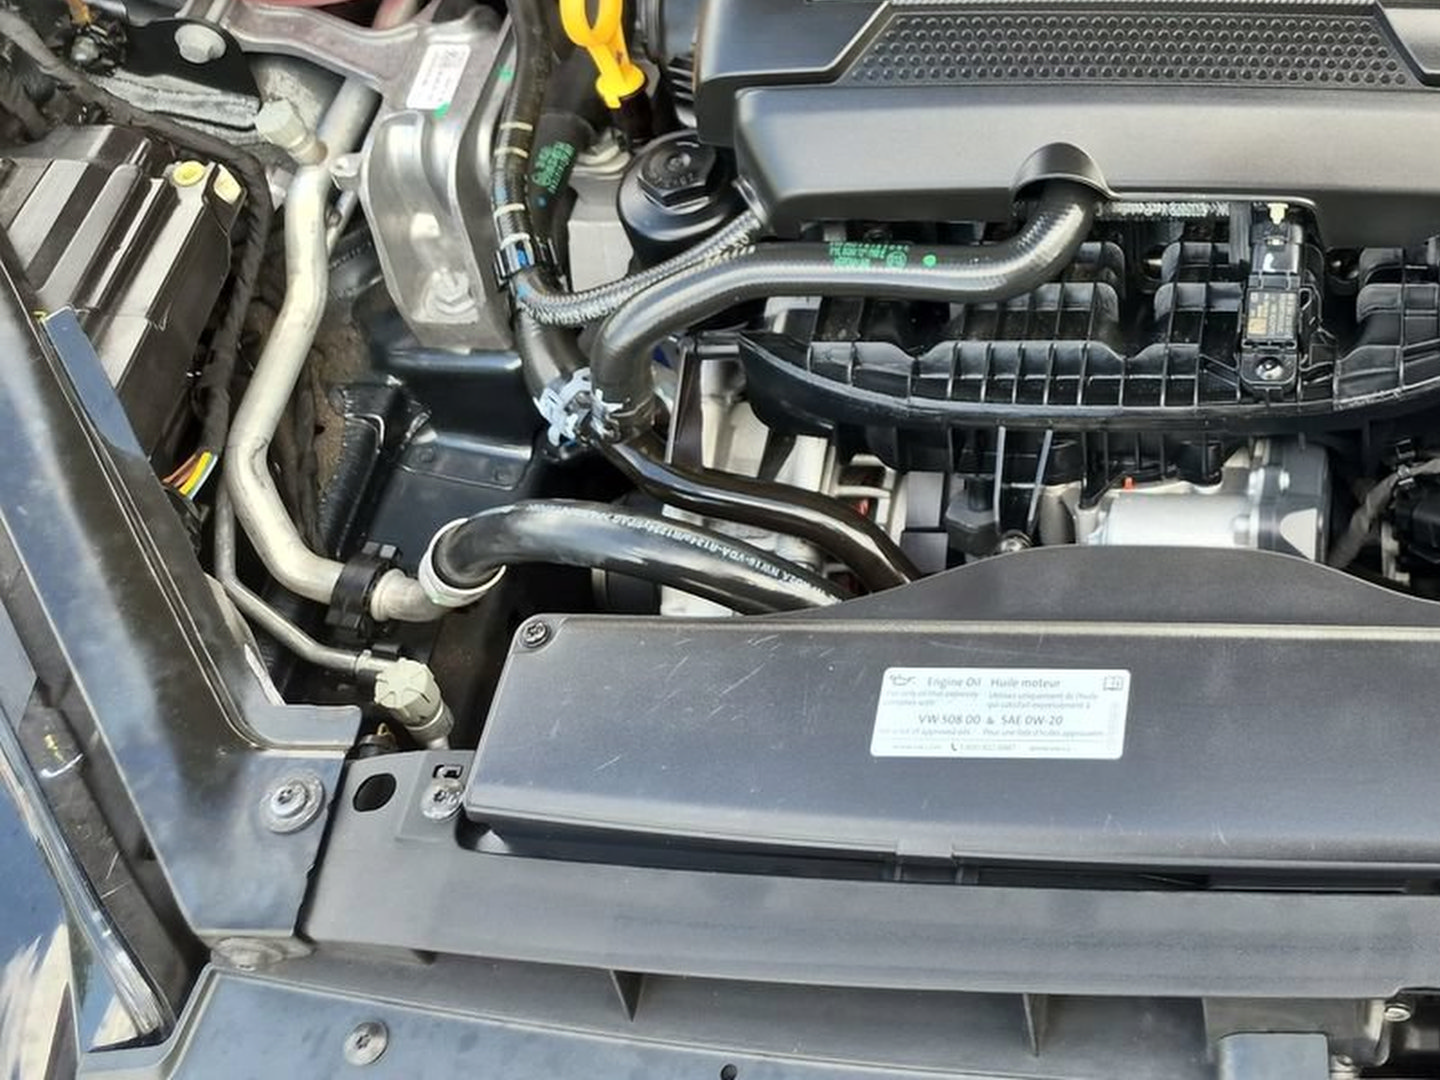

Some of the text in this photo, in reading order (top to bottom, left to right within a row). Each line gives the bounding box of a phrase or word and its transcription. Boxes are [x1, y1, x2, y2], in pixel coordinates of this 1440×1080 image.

[928, 676, 1061, 689] Engine Oil Huile moteur
[919, 713, 940, 725] VW
[941, 713, 964, 725] 508
[965, 713, 982, 725] 00
[986, 715, 996, 725] &
[1001, 714, 1022, 726] SAE
